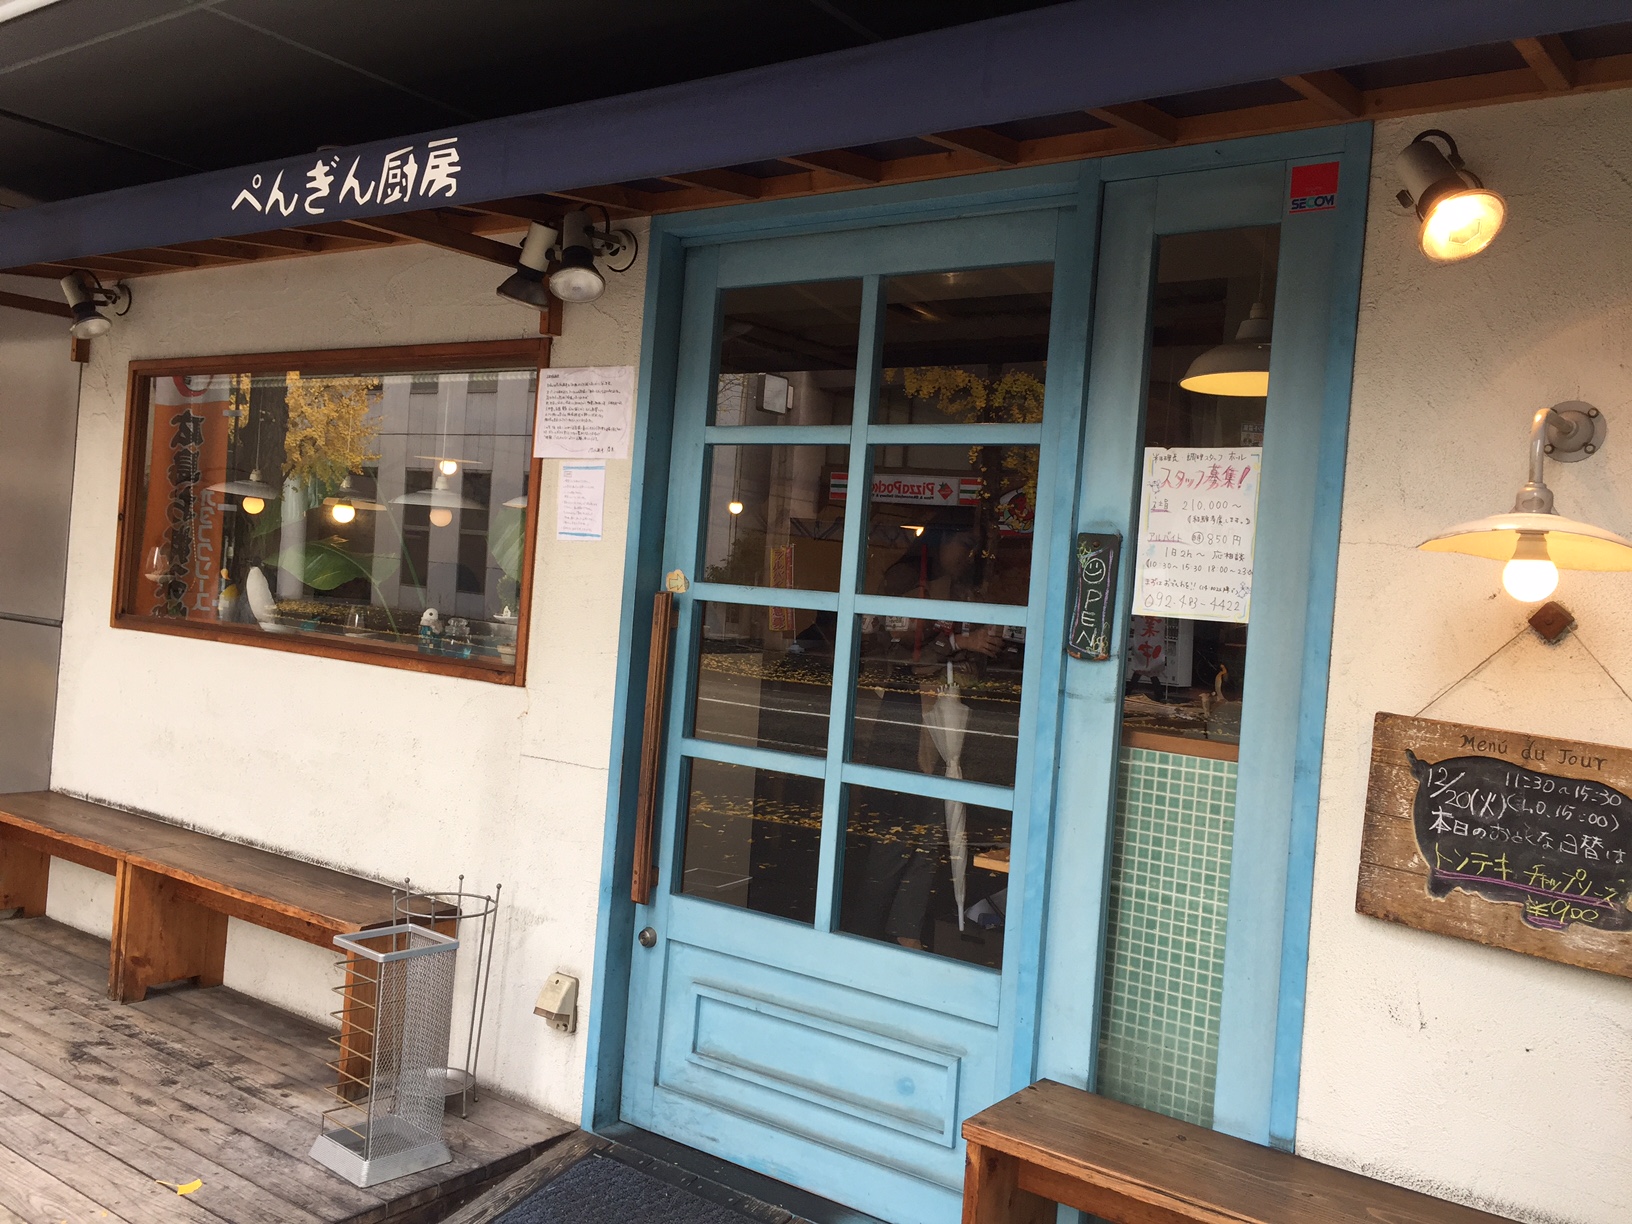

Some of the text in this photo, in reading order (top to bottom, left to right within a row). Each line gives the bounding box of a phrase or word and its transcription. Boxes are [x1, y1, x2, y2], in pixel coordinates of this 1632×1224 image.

[231, 137, 462, 217] ぺんぎん厨房
[1291, 195, 1335, 210] SECOM
[1160, 463, 1251, 491] スタッフ募集!
[1521, 739, 1546, 761] du
[1558, 748, 1608, 772] Jour
[1435, 842, 1513, 881] トンテキ
